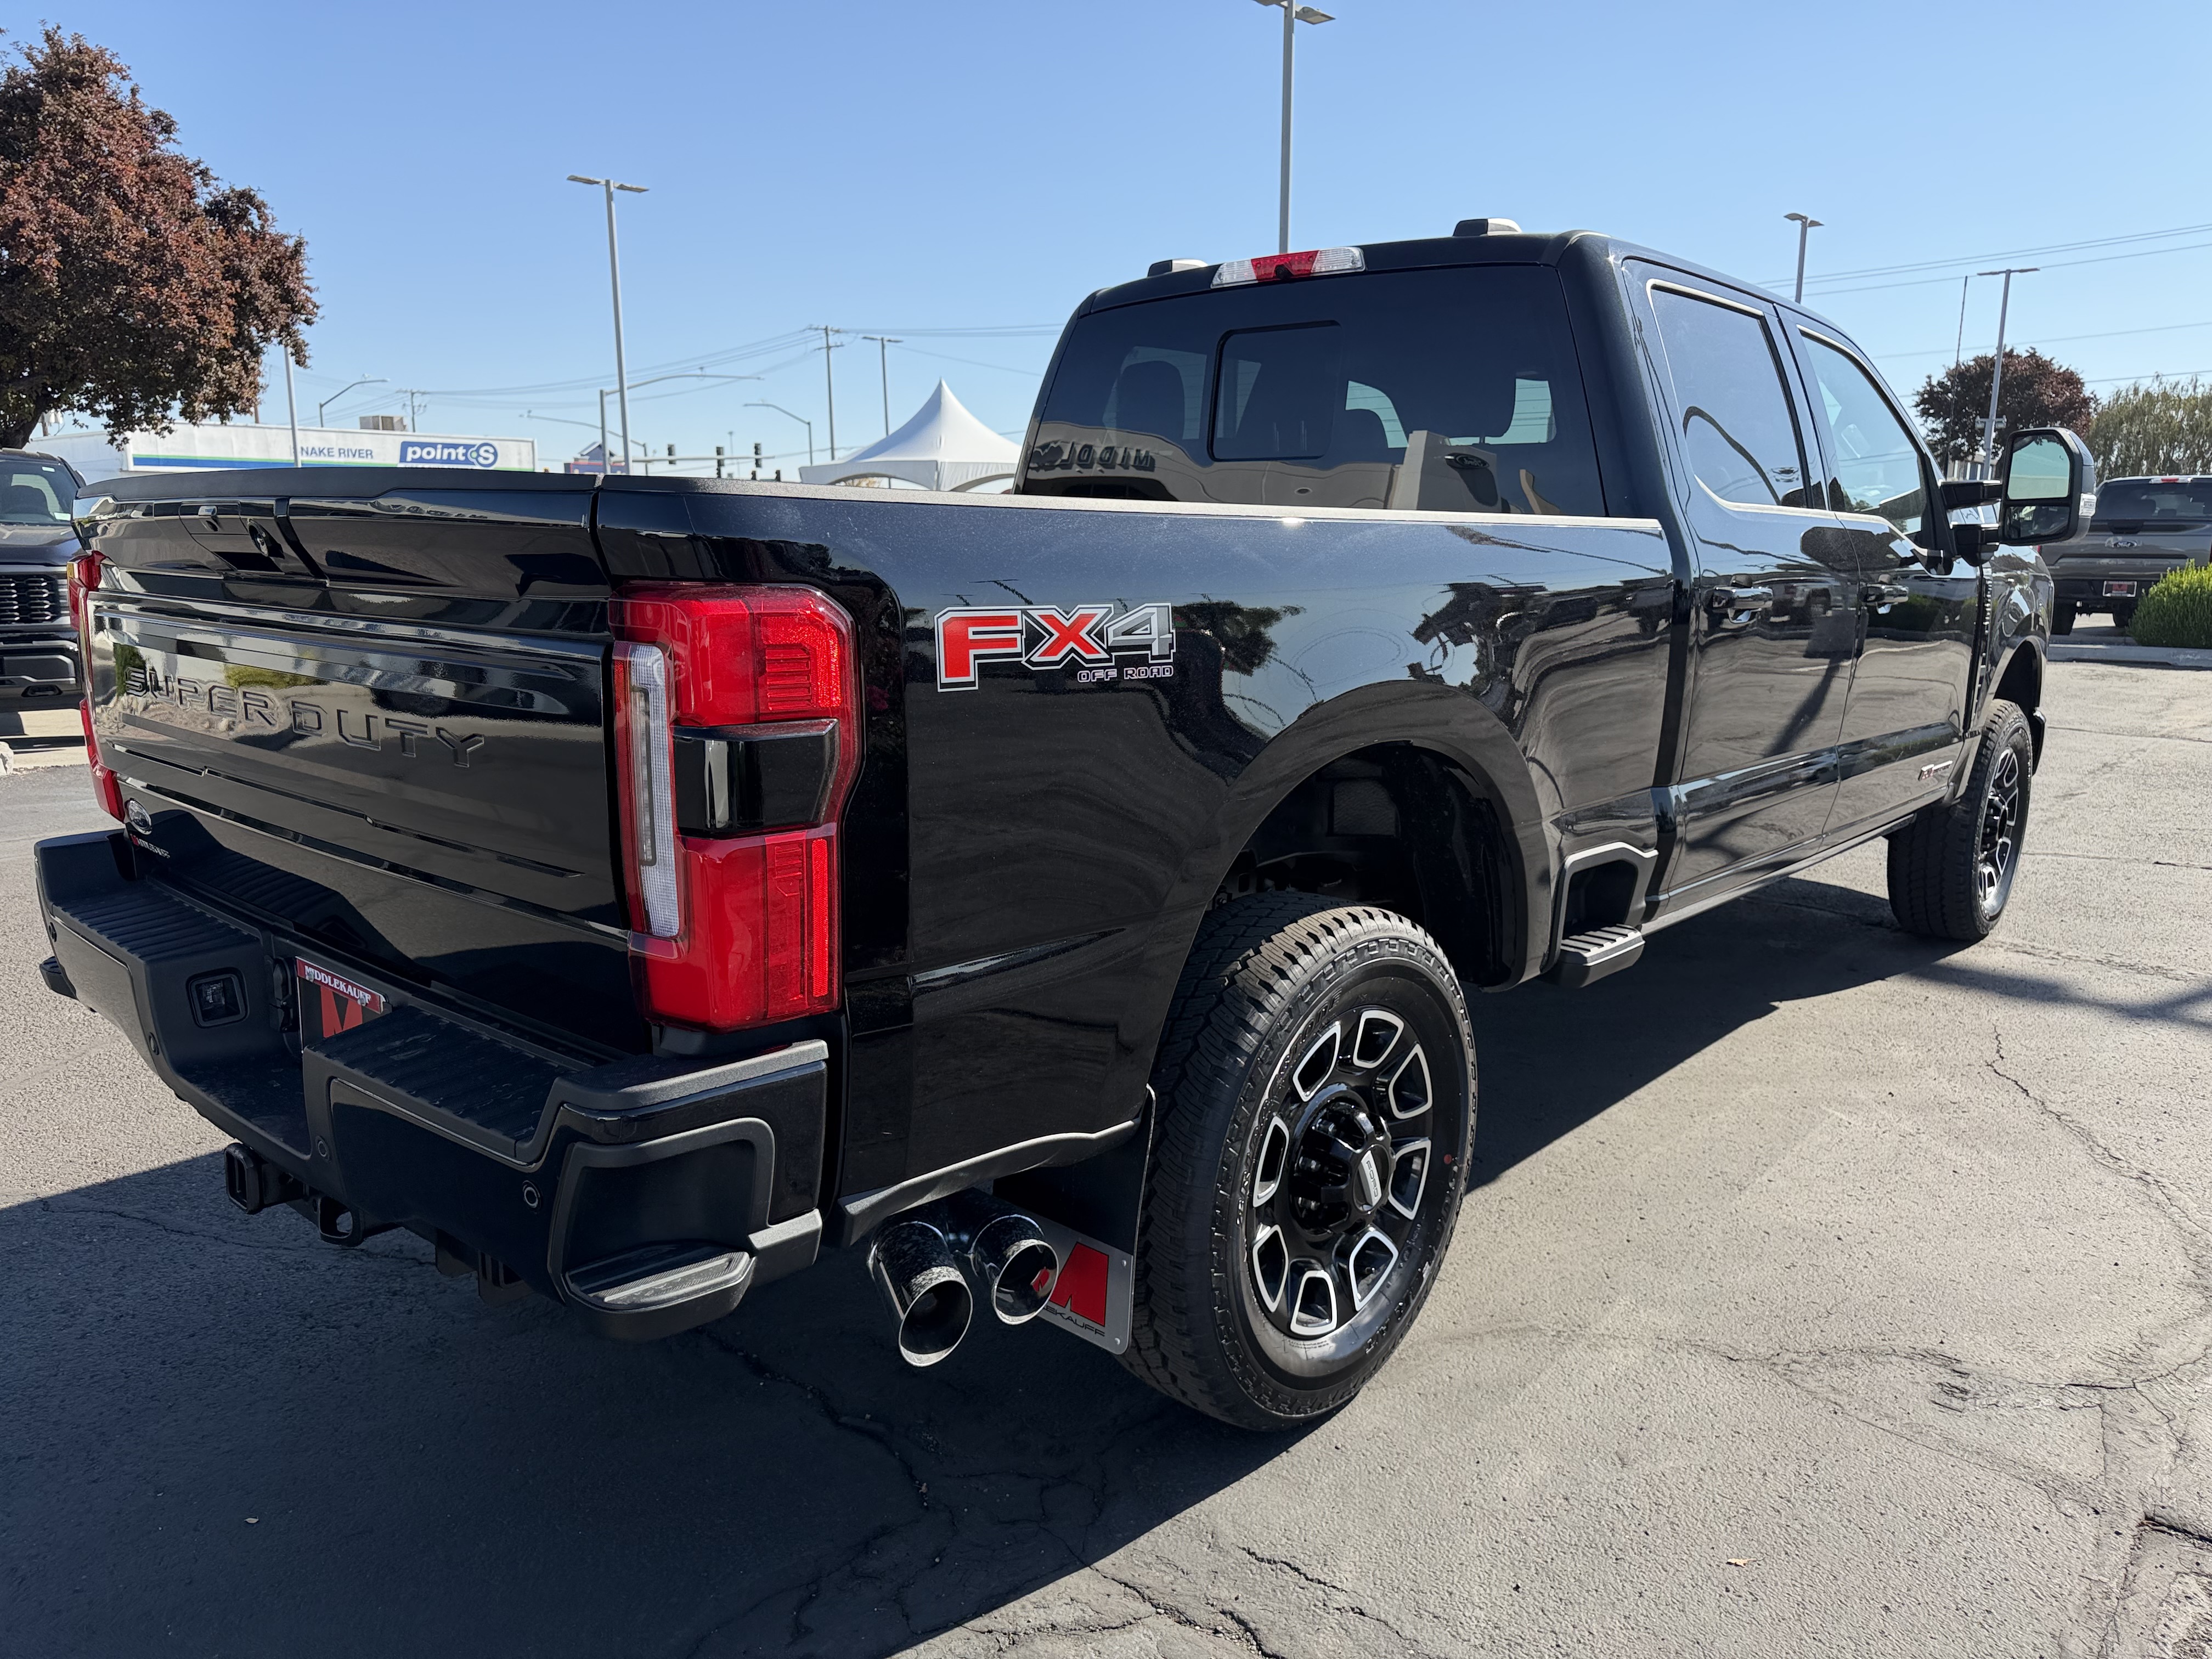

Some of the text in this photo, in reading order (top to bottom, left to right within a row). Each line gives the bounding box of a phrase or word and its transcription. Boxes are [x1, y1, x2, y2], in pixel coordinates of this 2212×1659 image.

[300, 446, 374, 459] NAKE RIVER
[406, 444, 495, 465] point S
[934, 603, 1176, 692] FX4
[1077, 665, 1174, 683] OFF ROAD
[123, 666, 485, 768] SUPER DUTY
[1365, 1160, 1379, 1198] FORD
[1045, 1304, 1105, 1337] EKAUFF
